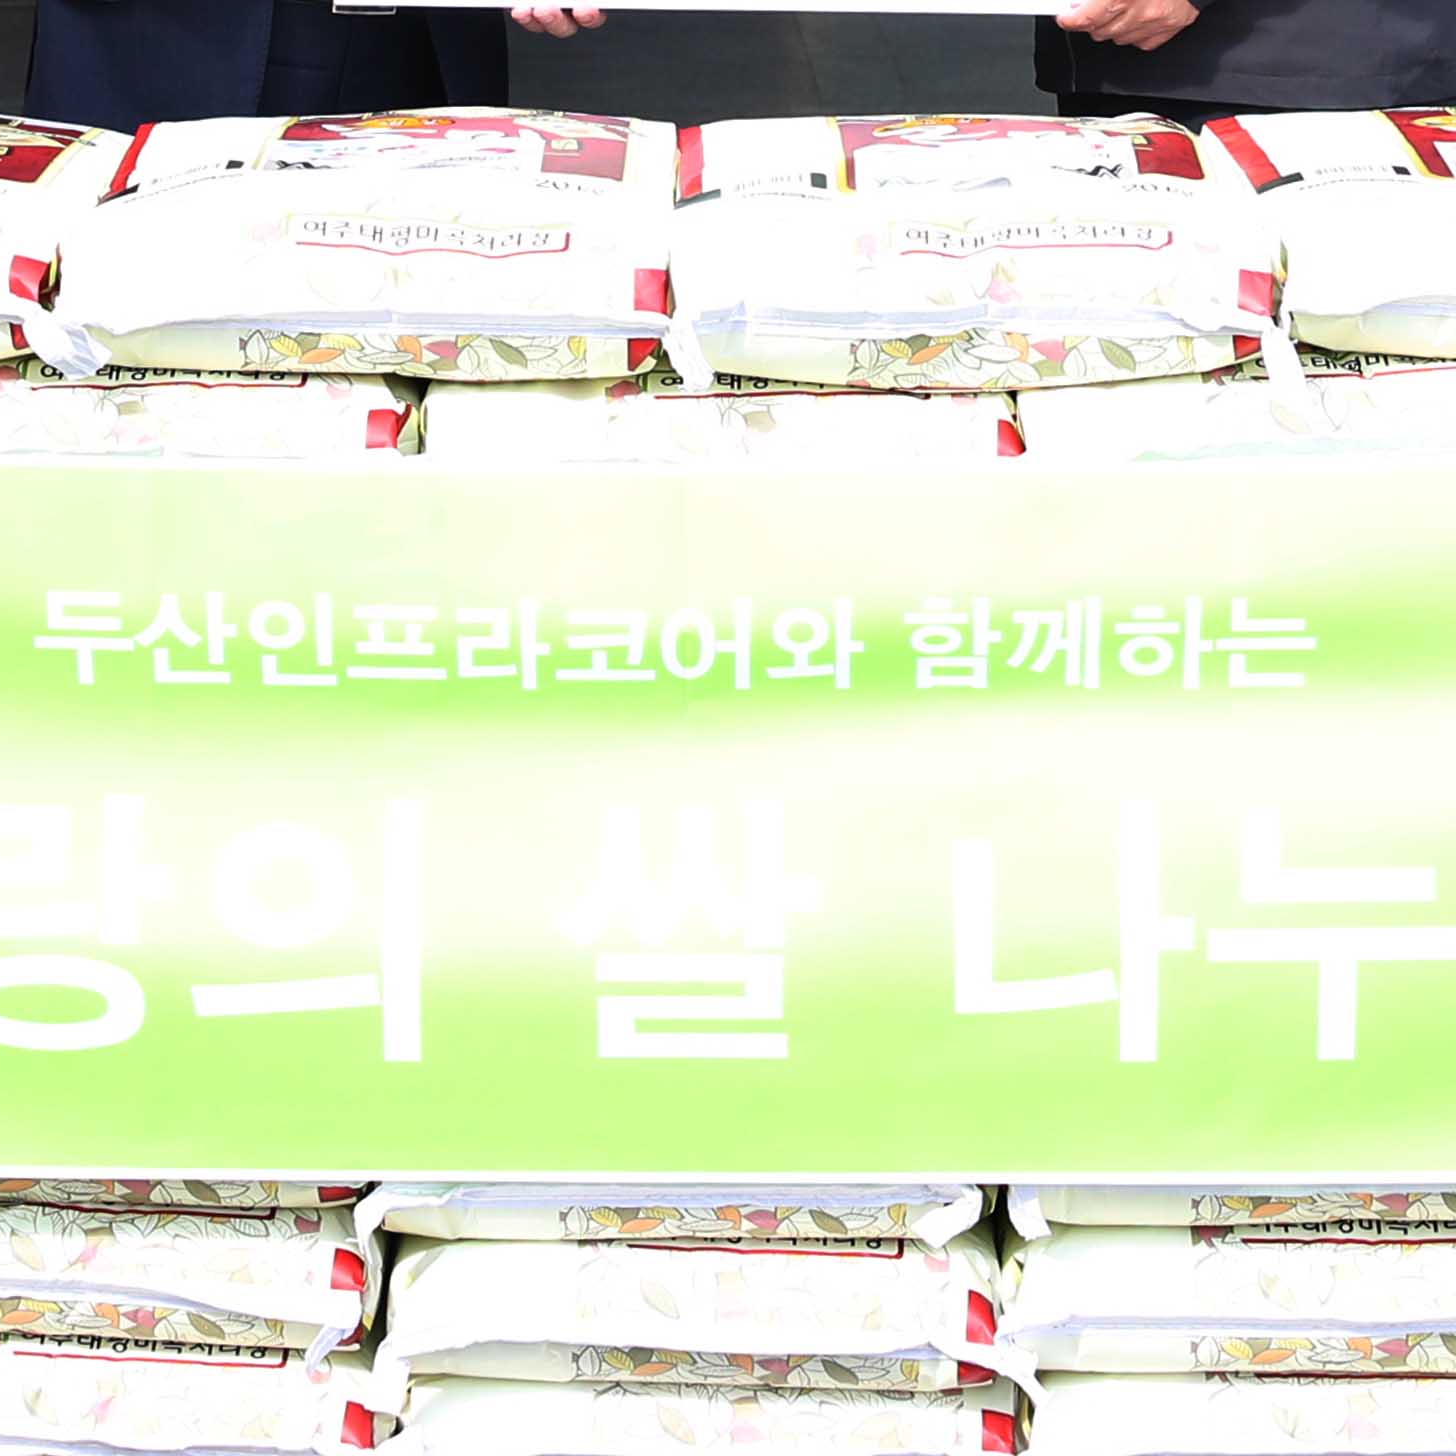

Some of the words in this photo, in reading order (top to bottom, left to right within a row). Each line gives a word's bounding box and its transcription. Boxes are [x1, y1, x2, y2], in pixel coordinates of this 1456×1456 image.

[33, 590, 865, 692] 두산인프라코어와
[902, 594, 1319, 692] 함께하는
[554, 796, 820, 1061] 쌀
